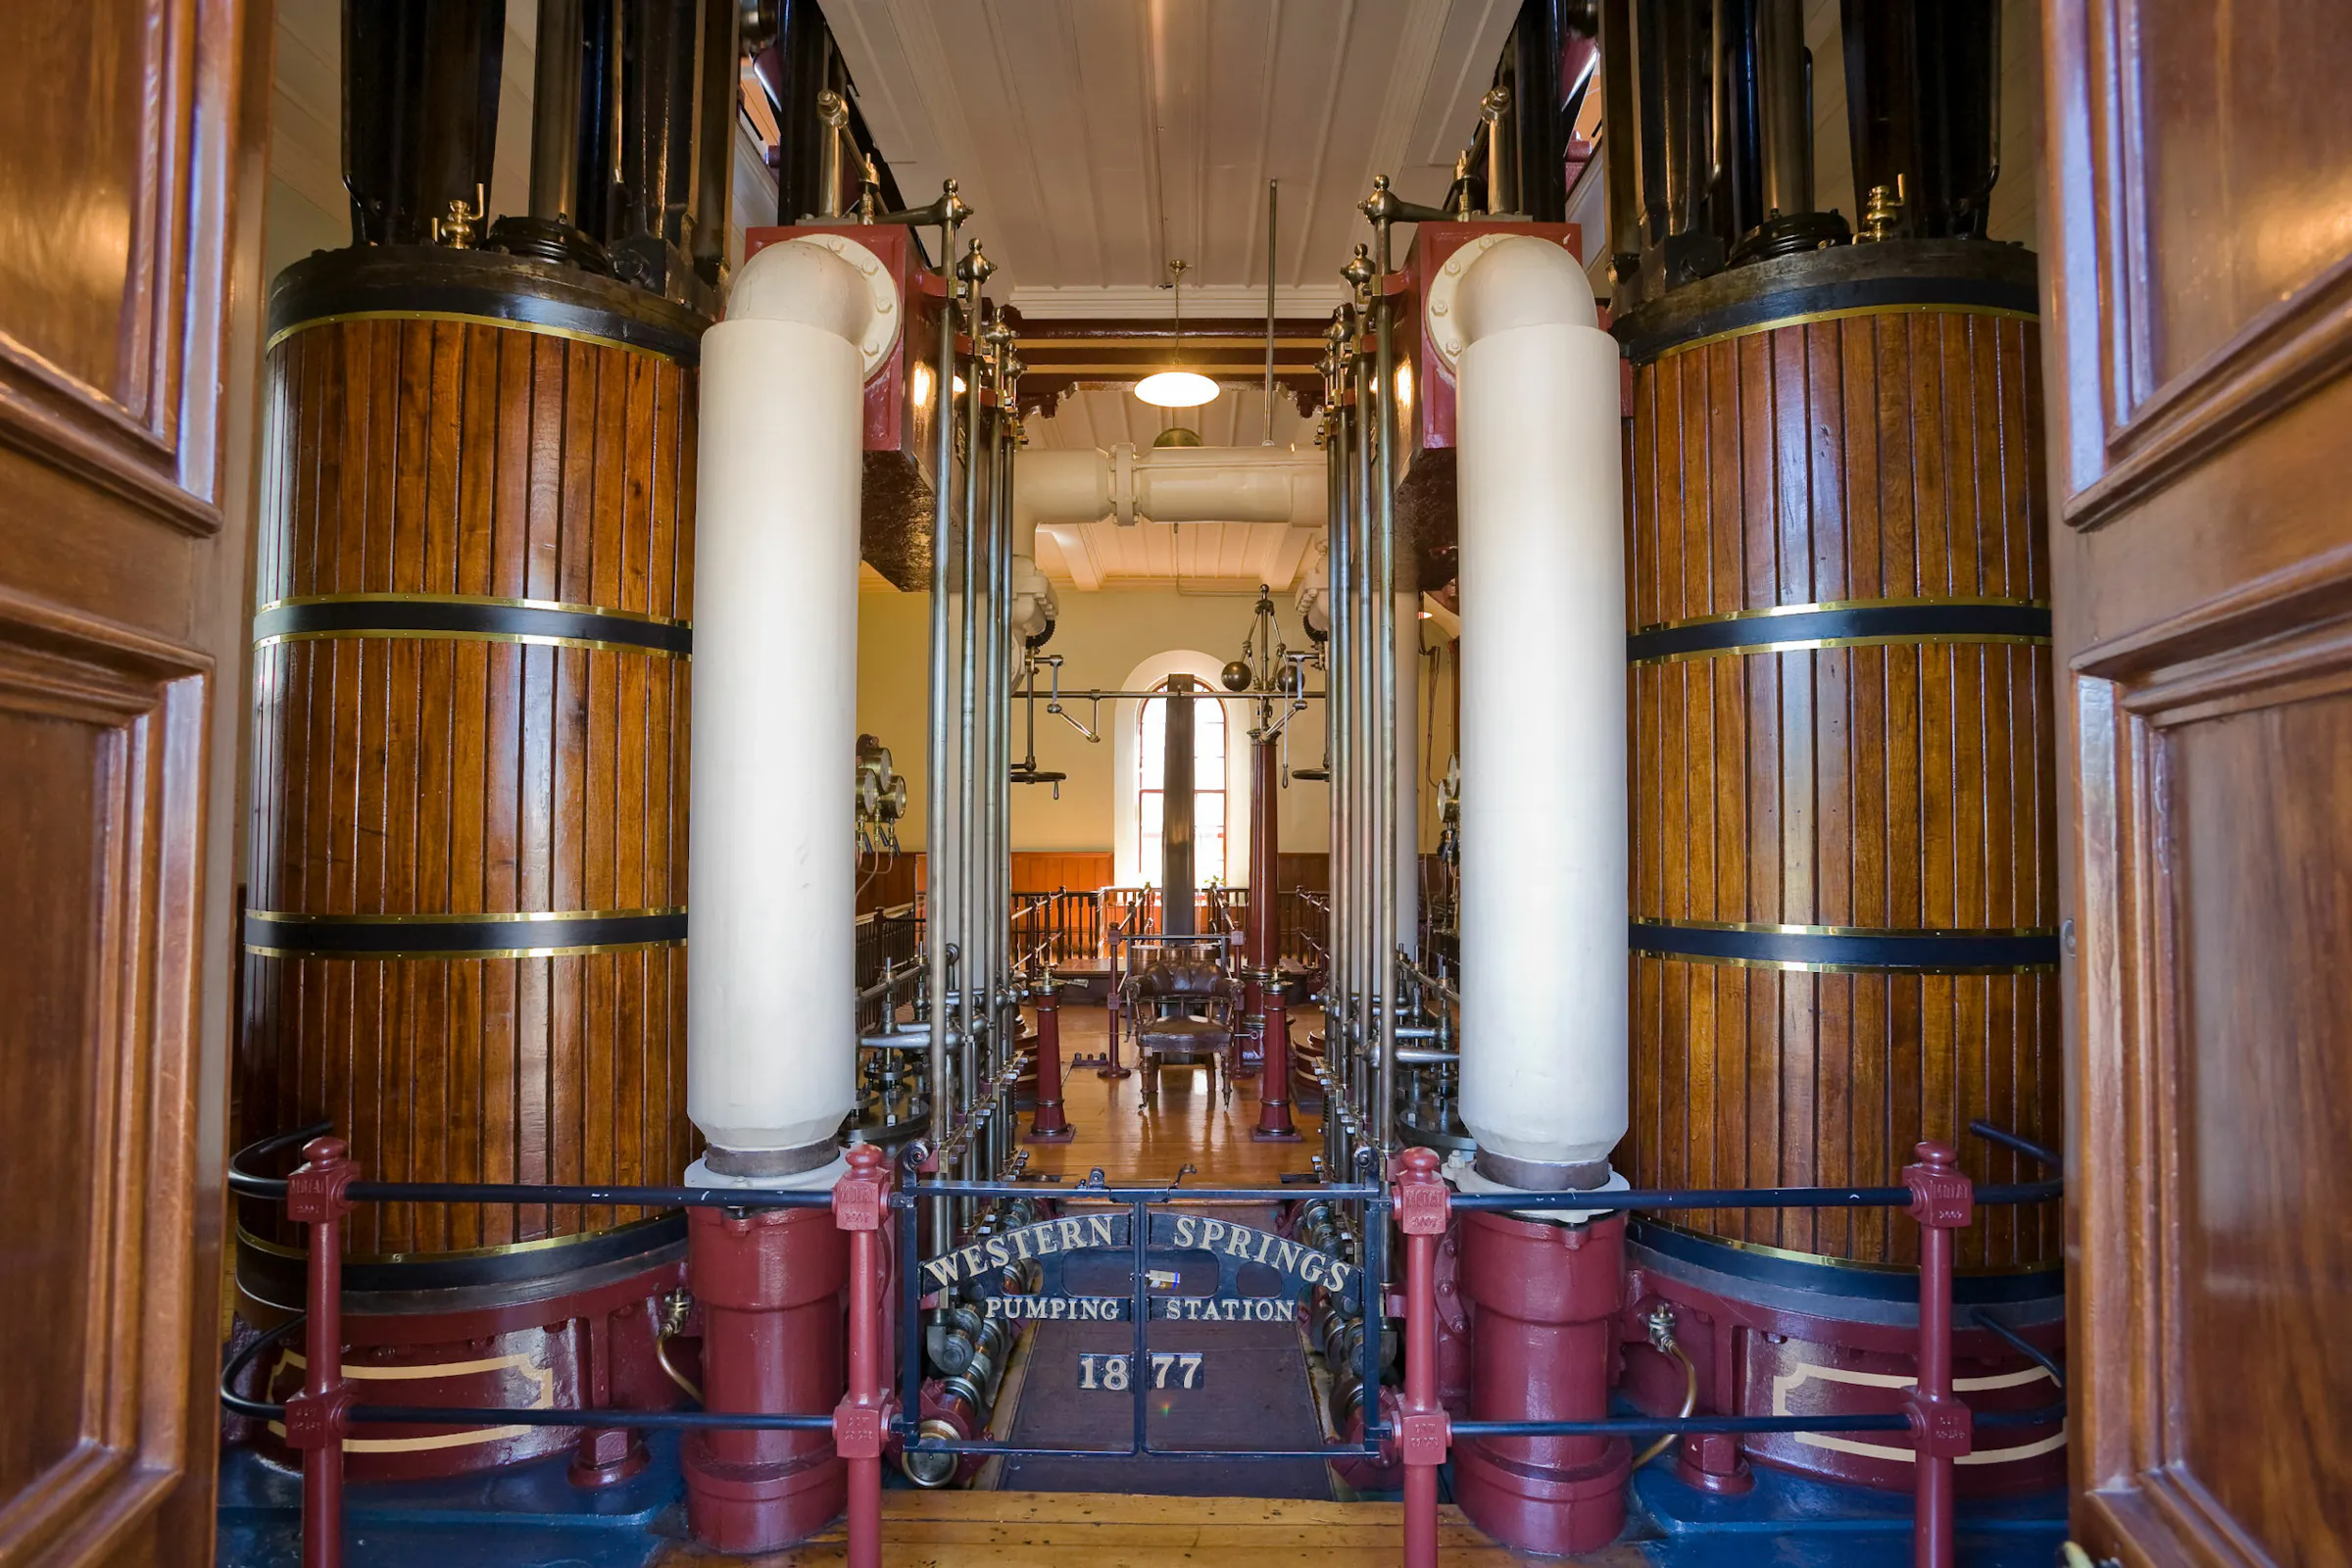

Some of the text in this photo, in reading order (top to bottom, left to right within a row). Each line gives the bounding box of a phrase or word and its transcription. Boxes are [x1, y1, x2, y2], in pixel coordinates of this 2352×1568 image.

[923, 1214, 1351, 1294] WESTERN SPRINGS
[985, 1298, 1295, 1322] PUMPING STATION
